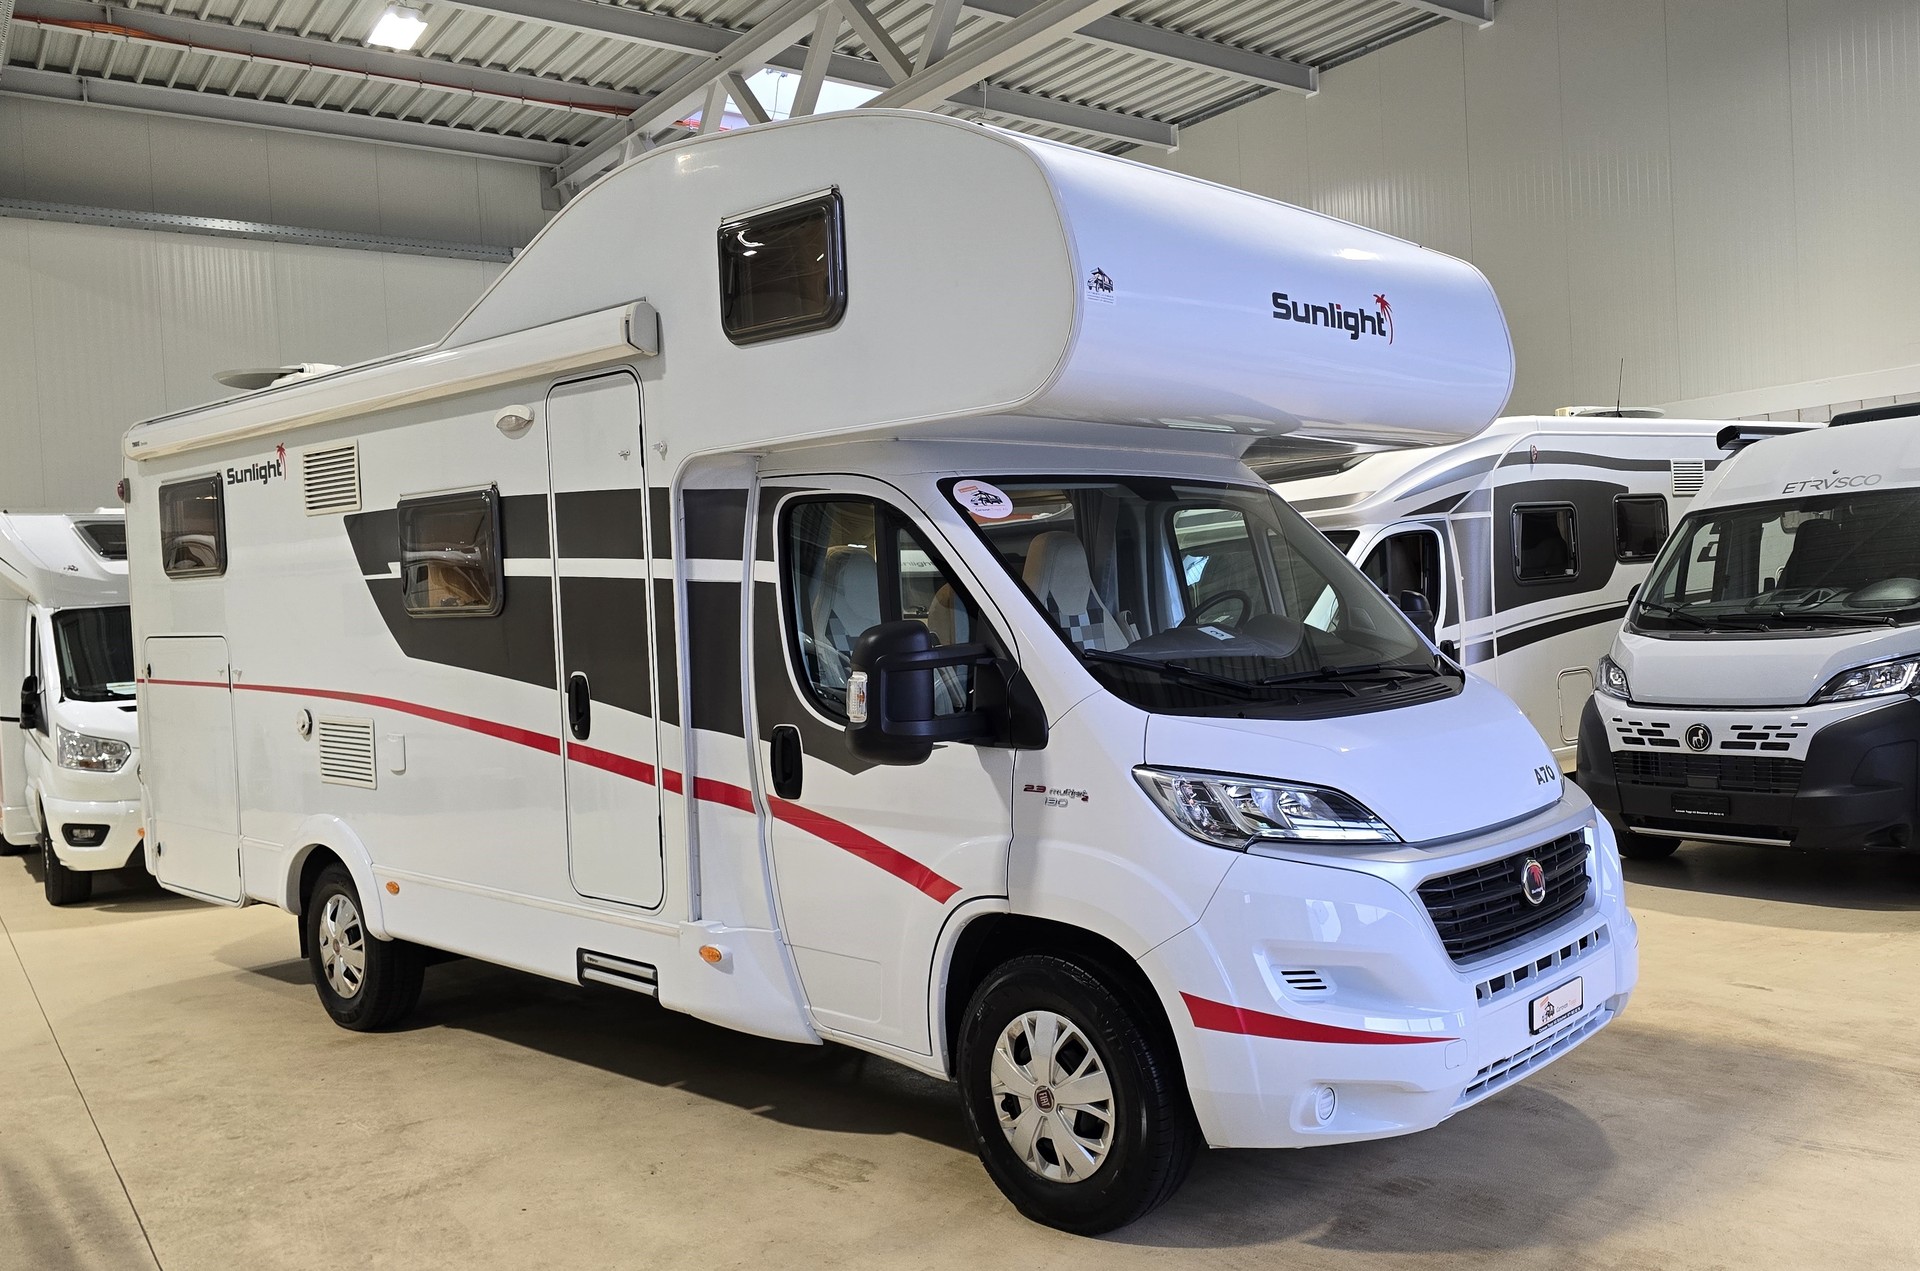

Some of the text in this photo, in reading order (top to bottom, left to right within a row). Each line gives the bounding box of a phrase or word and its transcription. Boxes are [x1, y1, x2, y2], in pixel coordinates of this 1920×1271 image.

[1271, 291, 1387, 341] Sunlight
[226, 458, 283, 485] Sunlight
[1533, 764, 1556, 786] A70
[1044, 796, 1069, 808] 130
[1039, 1091, 1050, 1106] FIAT
